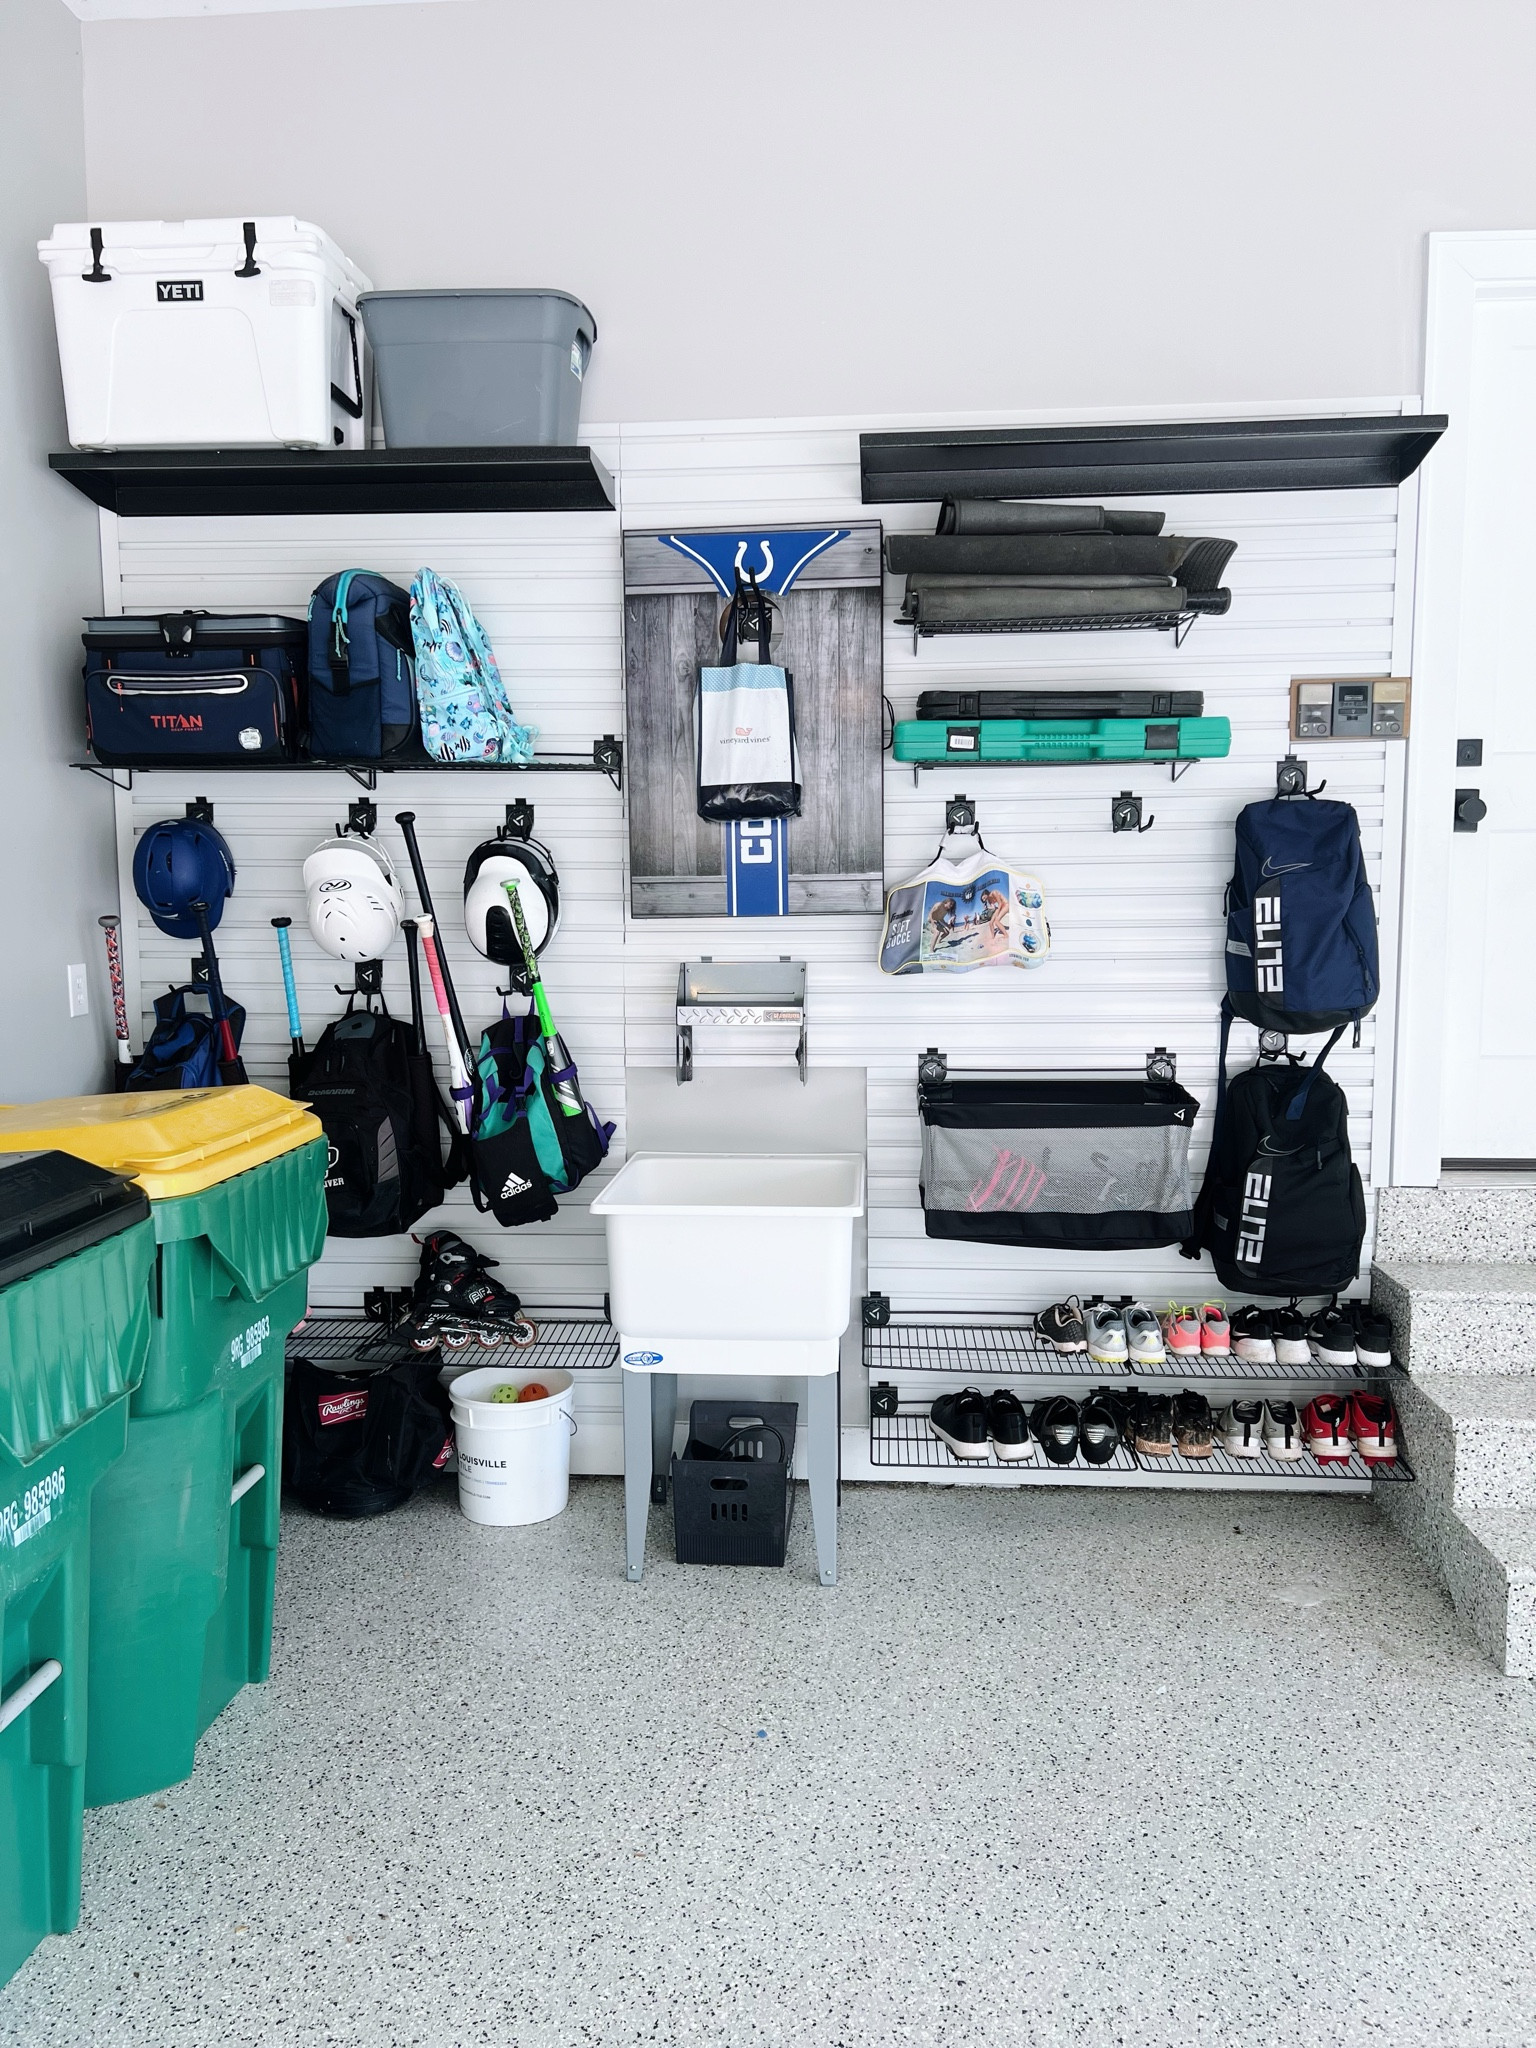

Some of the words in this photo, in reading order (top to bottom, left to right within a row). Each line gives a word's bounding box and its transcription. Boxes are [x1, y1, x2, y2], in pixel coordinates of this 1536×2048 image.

[158, 284, 201, 299] YETI
[150, 714, 203, 728] TITAN
[720, 737, 749, 745] vineyard
[1255, 896, 1284, 993] ELITE
[500, 1180, 533, 1200] adidas
[1236, 1172, 1272, 1264] ELITE
[246, 1315, 270, 1351] 985983
[322, 1398, 365, 1416] Rawlings
[24, 1465, 66, 1521] 985986
